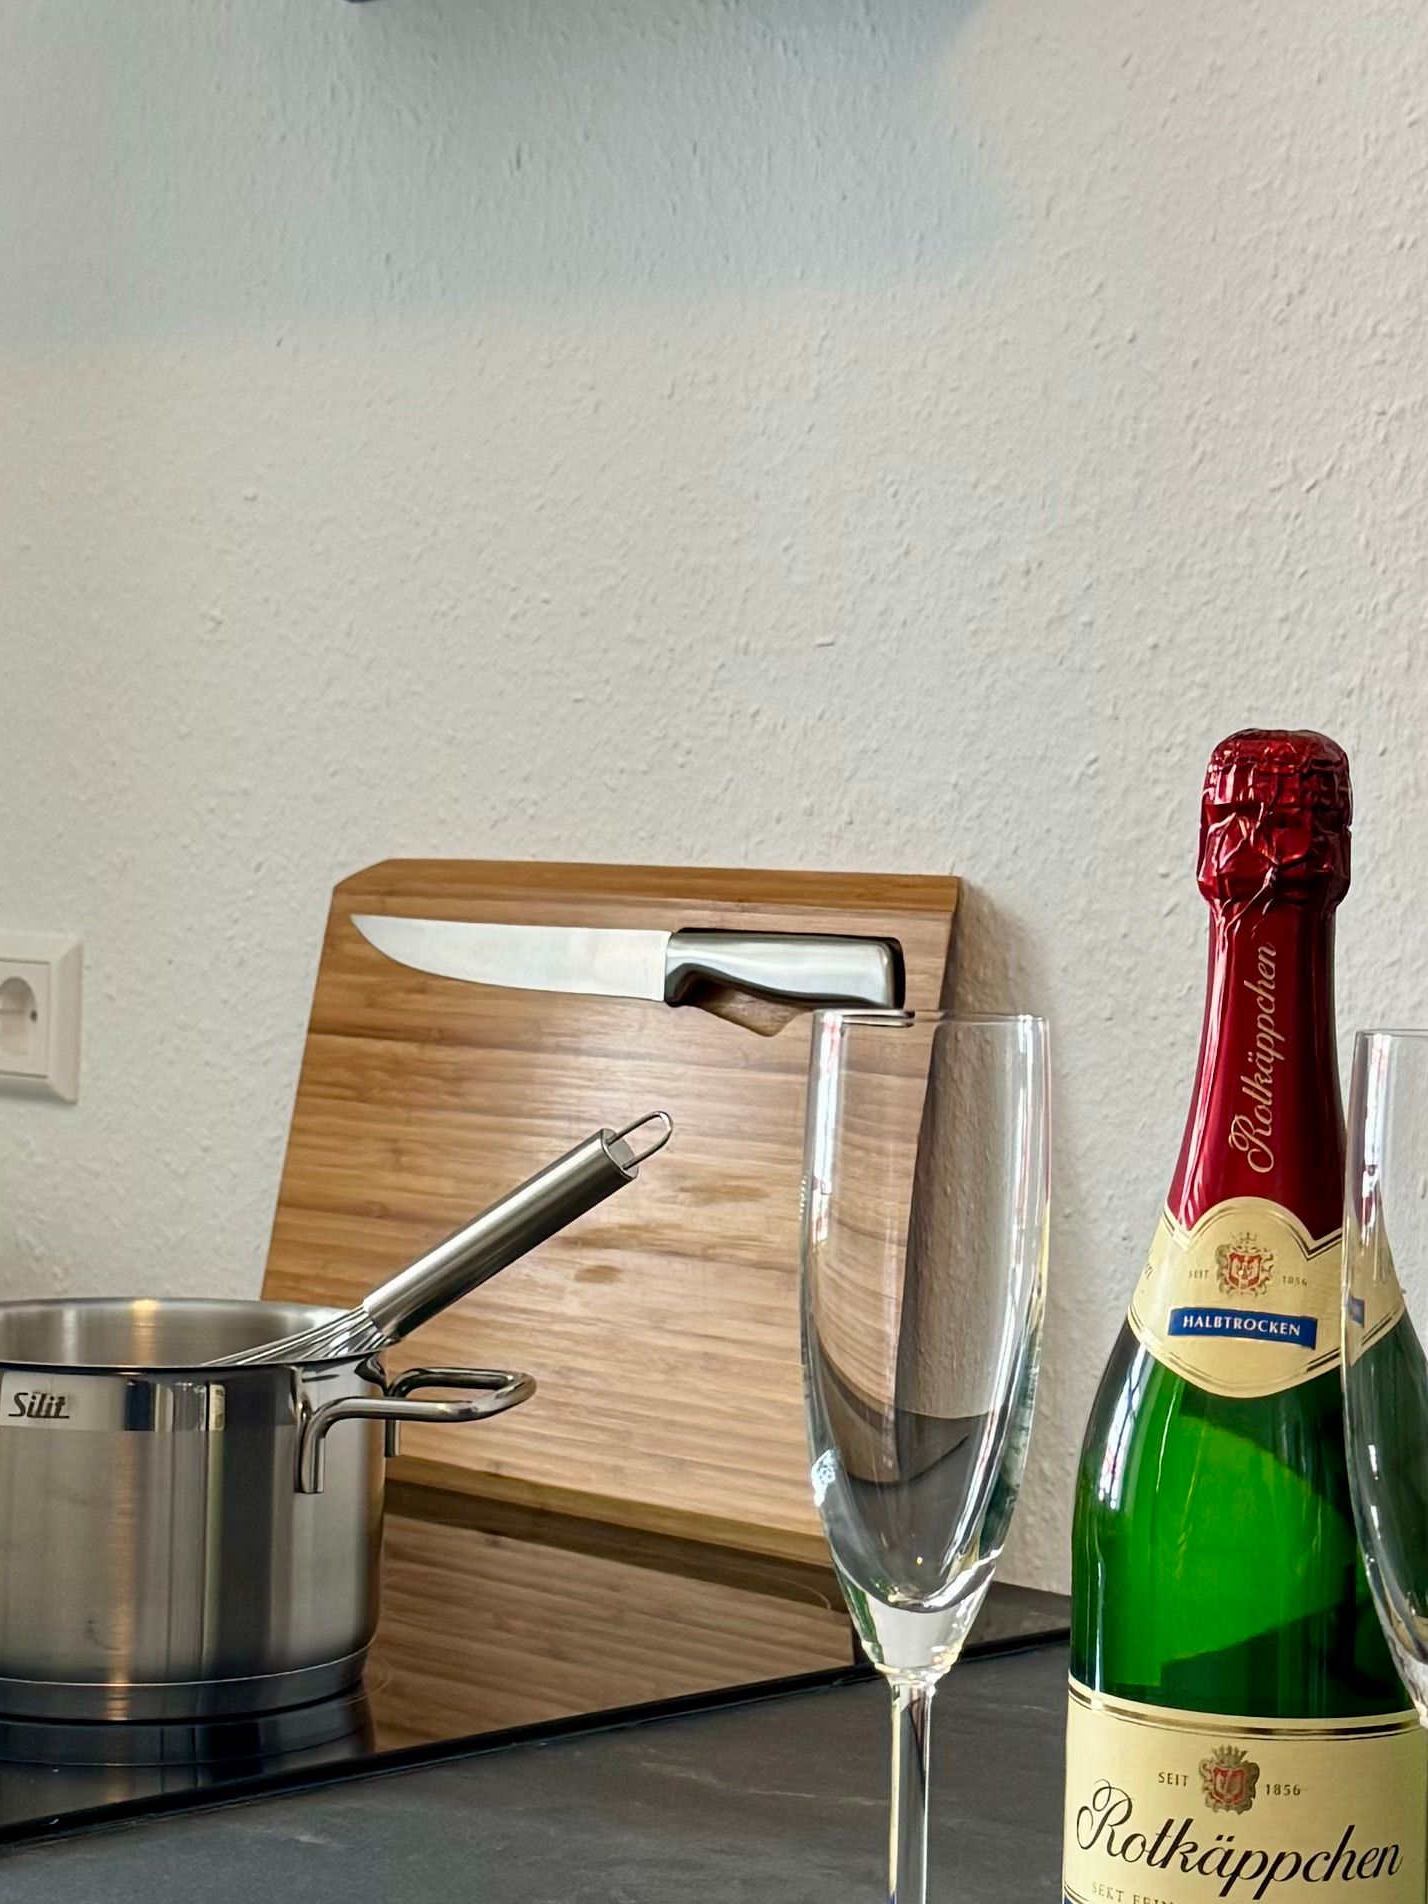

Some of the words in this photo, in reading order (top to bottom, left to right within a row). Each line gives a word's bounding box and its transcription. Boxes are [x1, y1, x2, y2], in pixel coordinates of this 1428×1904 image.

[1228, 941, 1286, 1173] Rotkäppchen
[1182, 1314, 1301, 1337] HALBTROCKEN
[8, 1391, 70, 1419] Silit
[1158, 1771, 1189, 1788] SEIT
[1265, 1783, 1302, 1797] 1856
[1076, 1778, 1404, 1901] Rotkäppchen
[1091, 1882, 1125, 1903] SEKT
